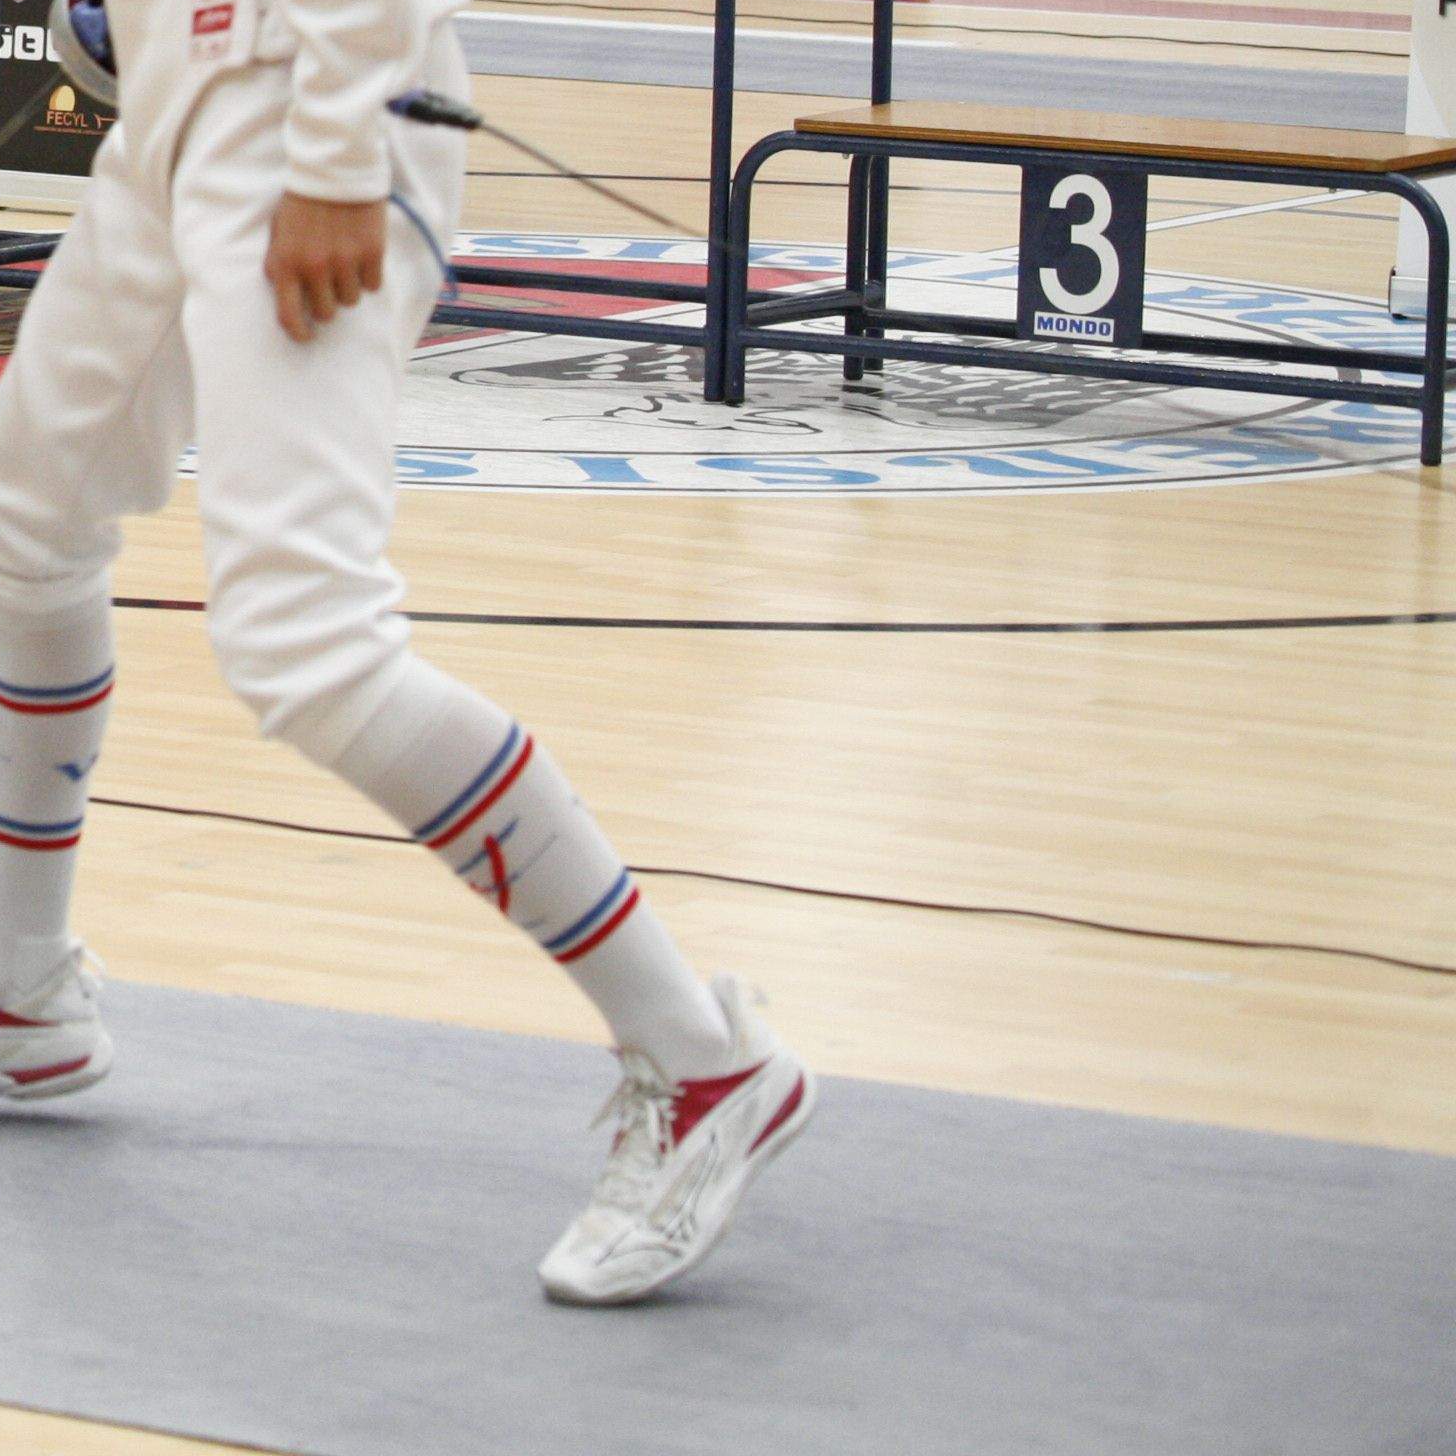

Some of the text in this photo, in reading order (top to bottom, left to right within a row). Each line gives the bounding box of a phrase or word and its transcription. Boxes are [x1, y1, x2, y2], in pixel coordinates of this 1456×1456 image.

[45, 111, 89, 129] FECYL
[1038, 173, 1120, 315] 3
[1036, 315, 1112, 337] MONDO
